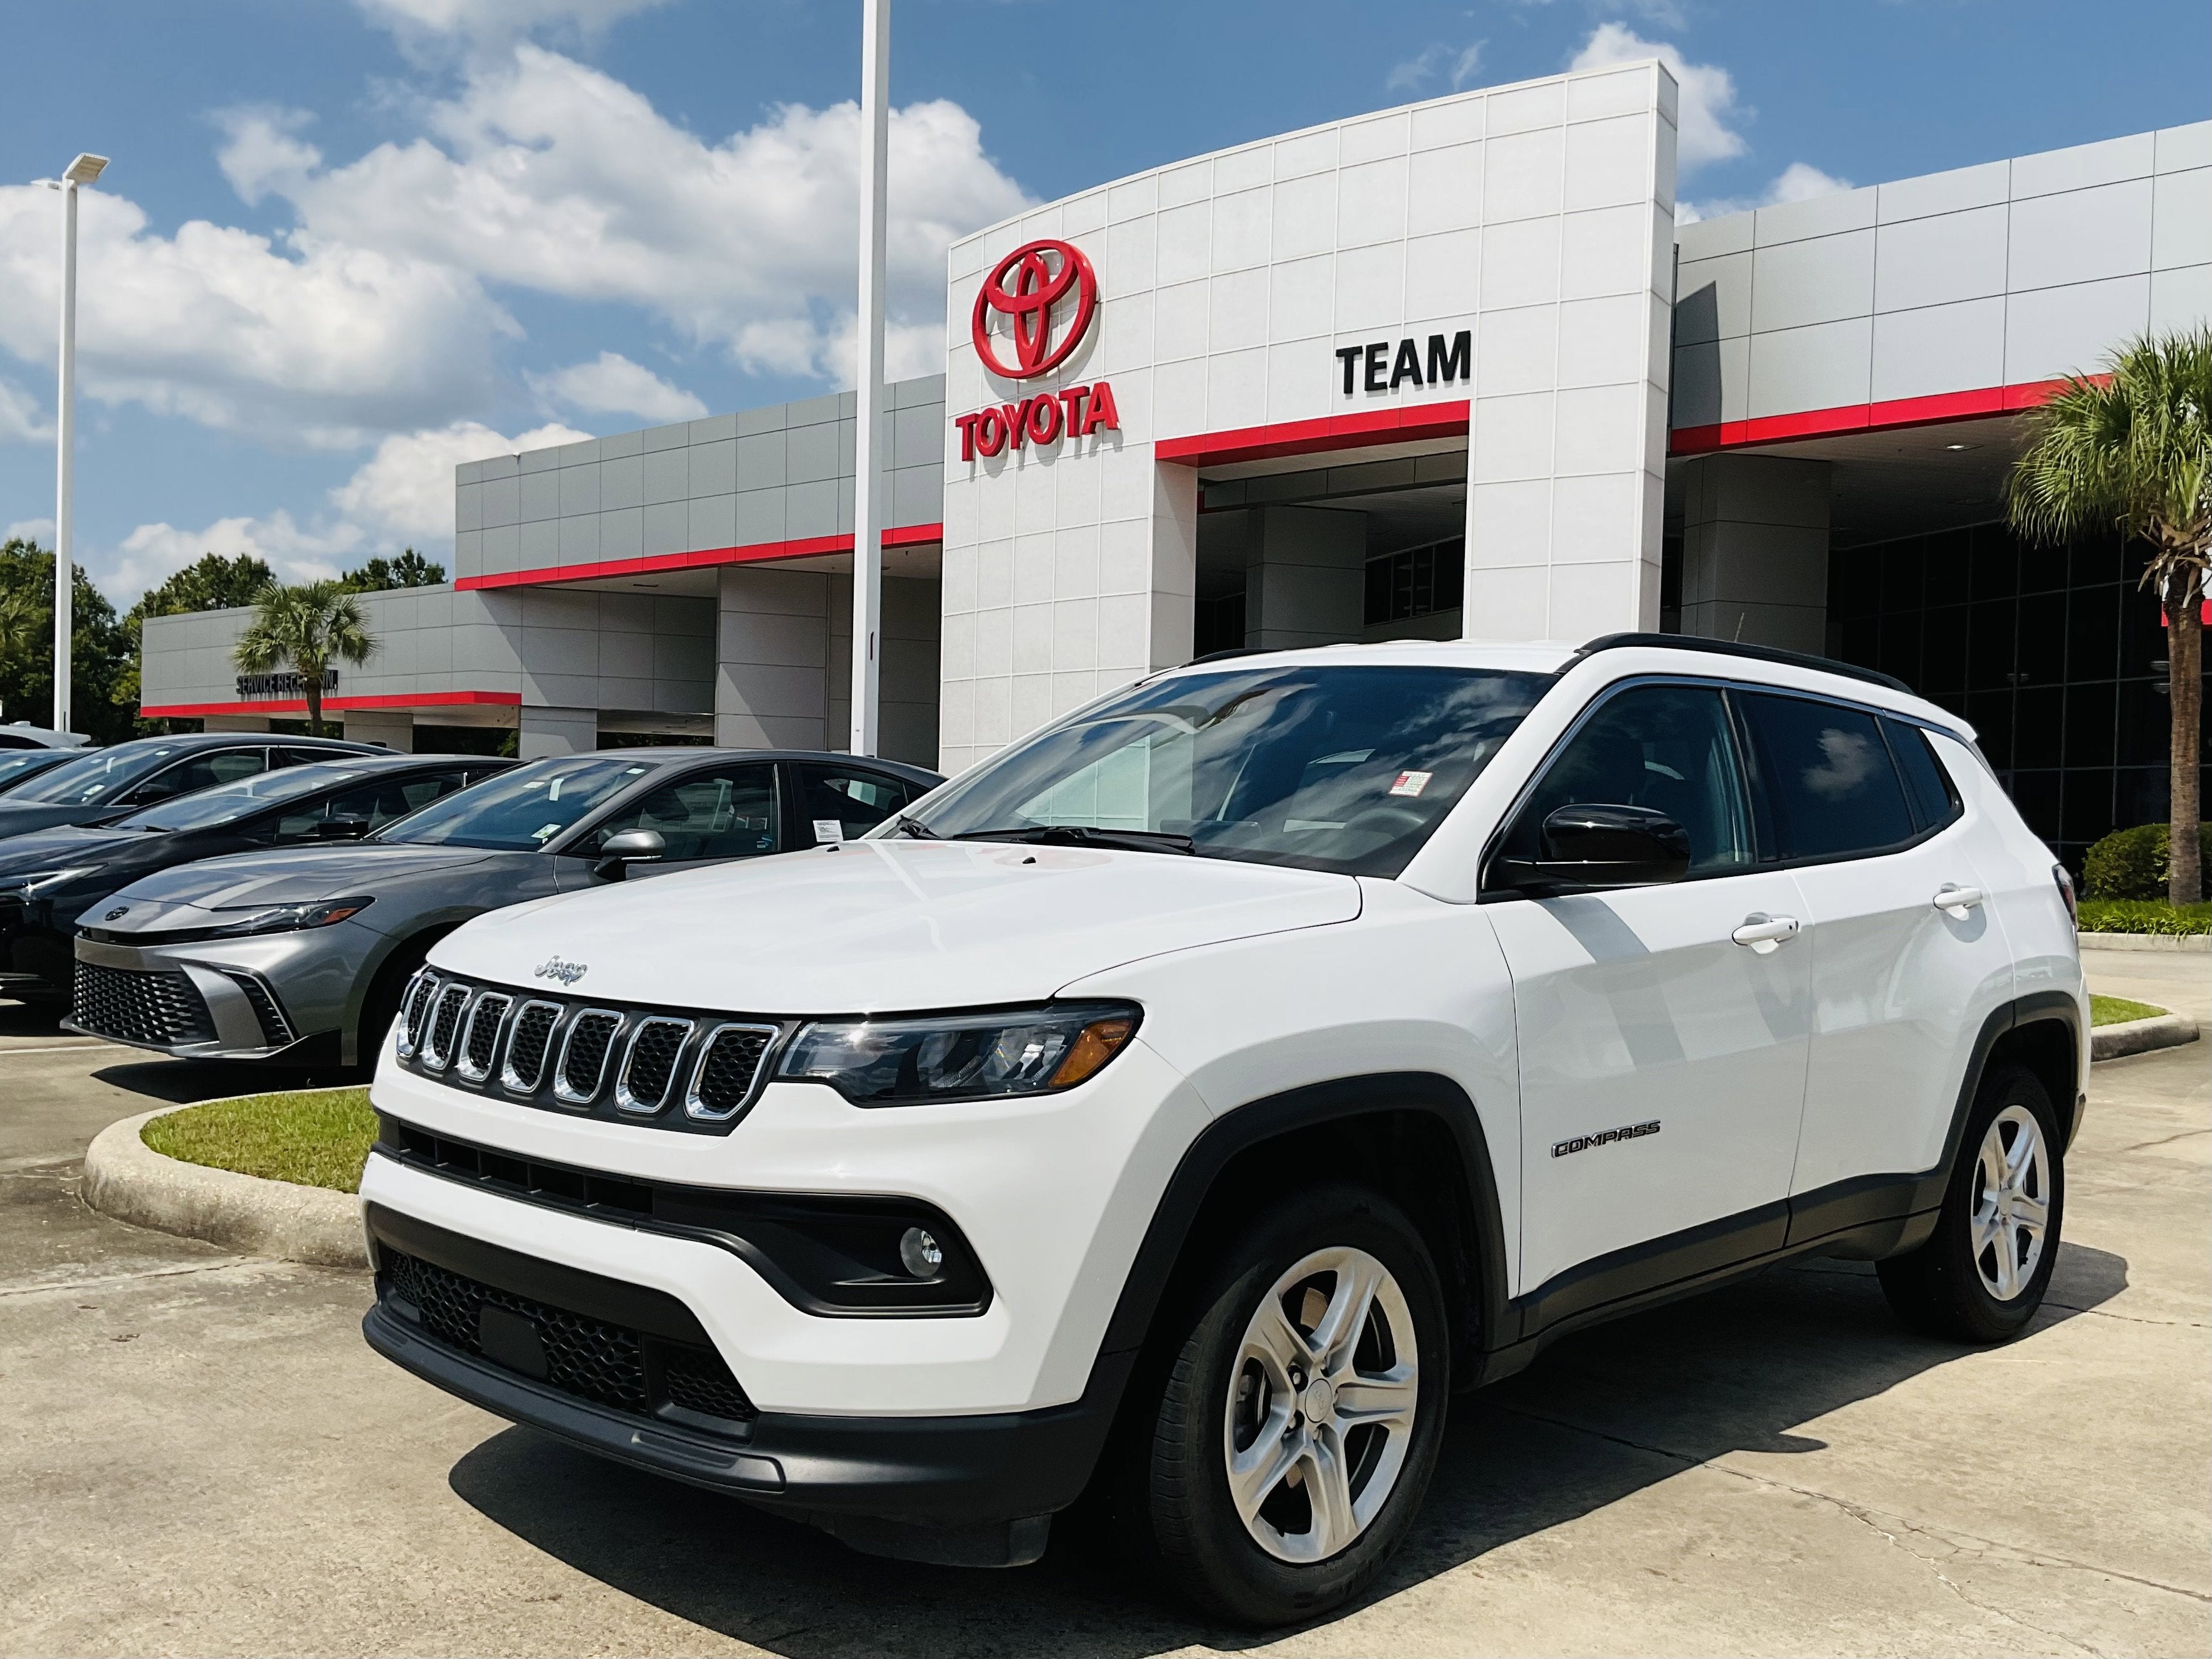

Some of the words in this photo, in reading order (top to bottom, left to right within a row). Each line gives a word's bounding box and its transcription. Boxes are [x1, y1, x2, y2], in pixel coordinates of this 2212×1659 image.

[1335, 330, 1471, 394] TEAM
[956, 381, 1121, 462] TOYOTA
[236, 674, 276, 694] SERVICE
[534, 955, 588, 987] Jeep
[1551, 1119, 1661, 1158] COMPASS
